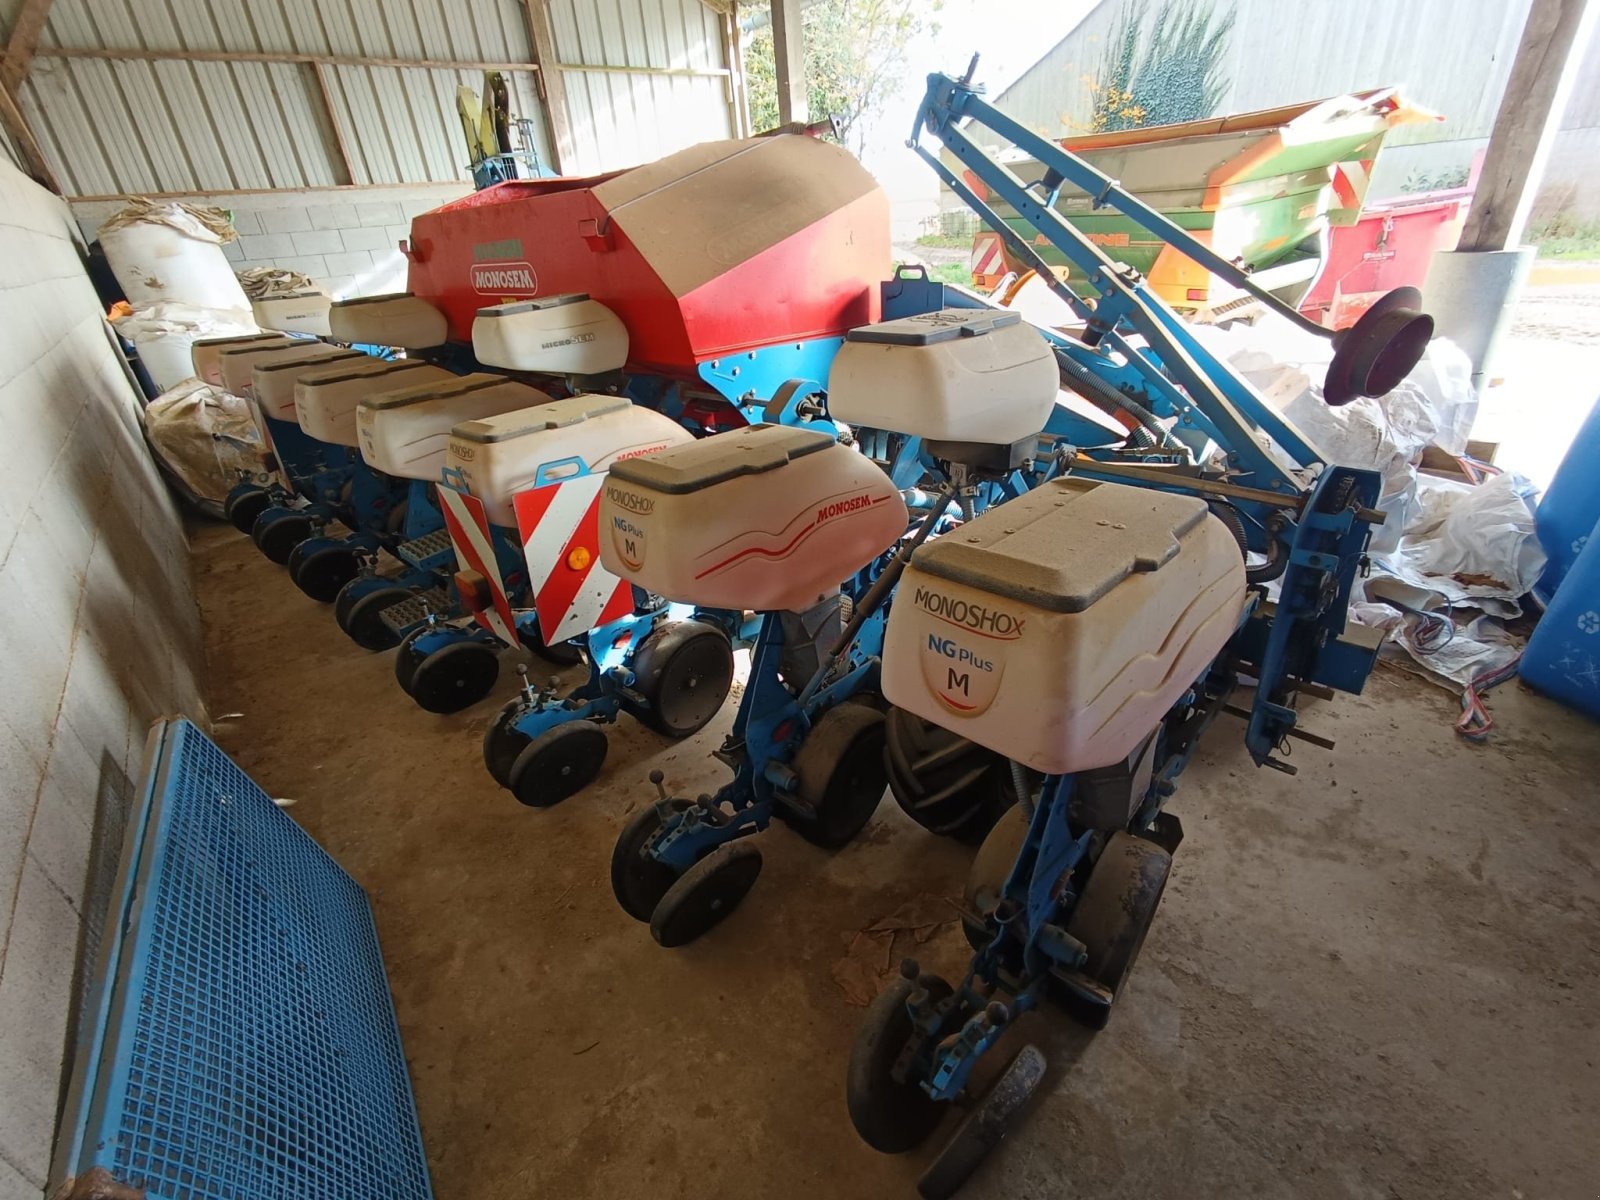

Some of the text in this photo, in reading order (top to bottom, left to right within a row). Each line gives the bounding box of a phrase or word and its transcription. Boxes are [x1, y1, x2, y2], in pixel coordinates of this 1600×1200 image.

[475, 269, 535, 289] MONOSEM
[606, 486, 655, 511] MONOSHOX
[816, 495, 871, 524] MONOSEM
[614, 516, 627, 532] NG
[625, 538, 636, 559] M
[914, 587, 1026, 636] MONOSHOX
[928, 633, 993, 672] NG Plus
[947, 667, 970, 697] M
